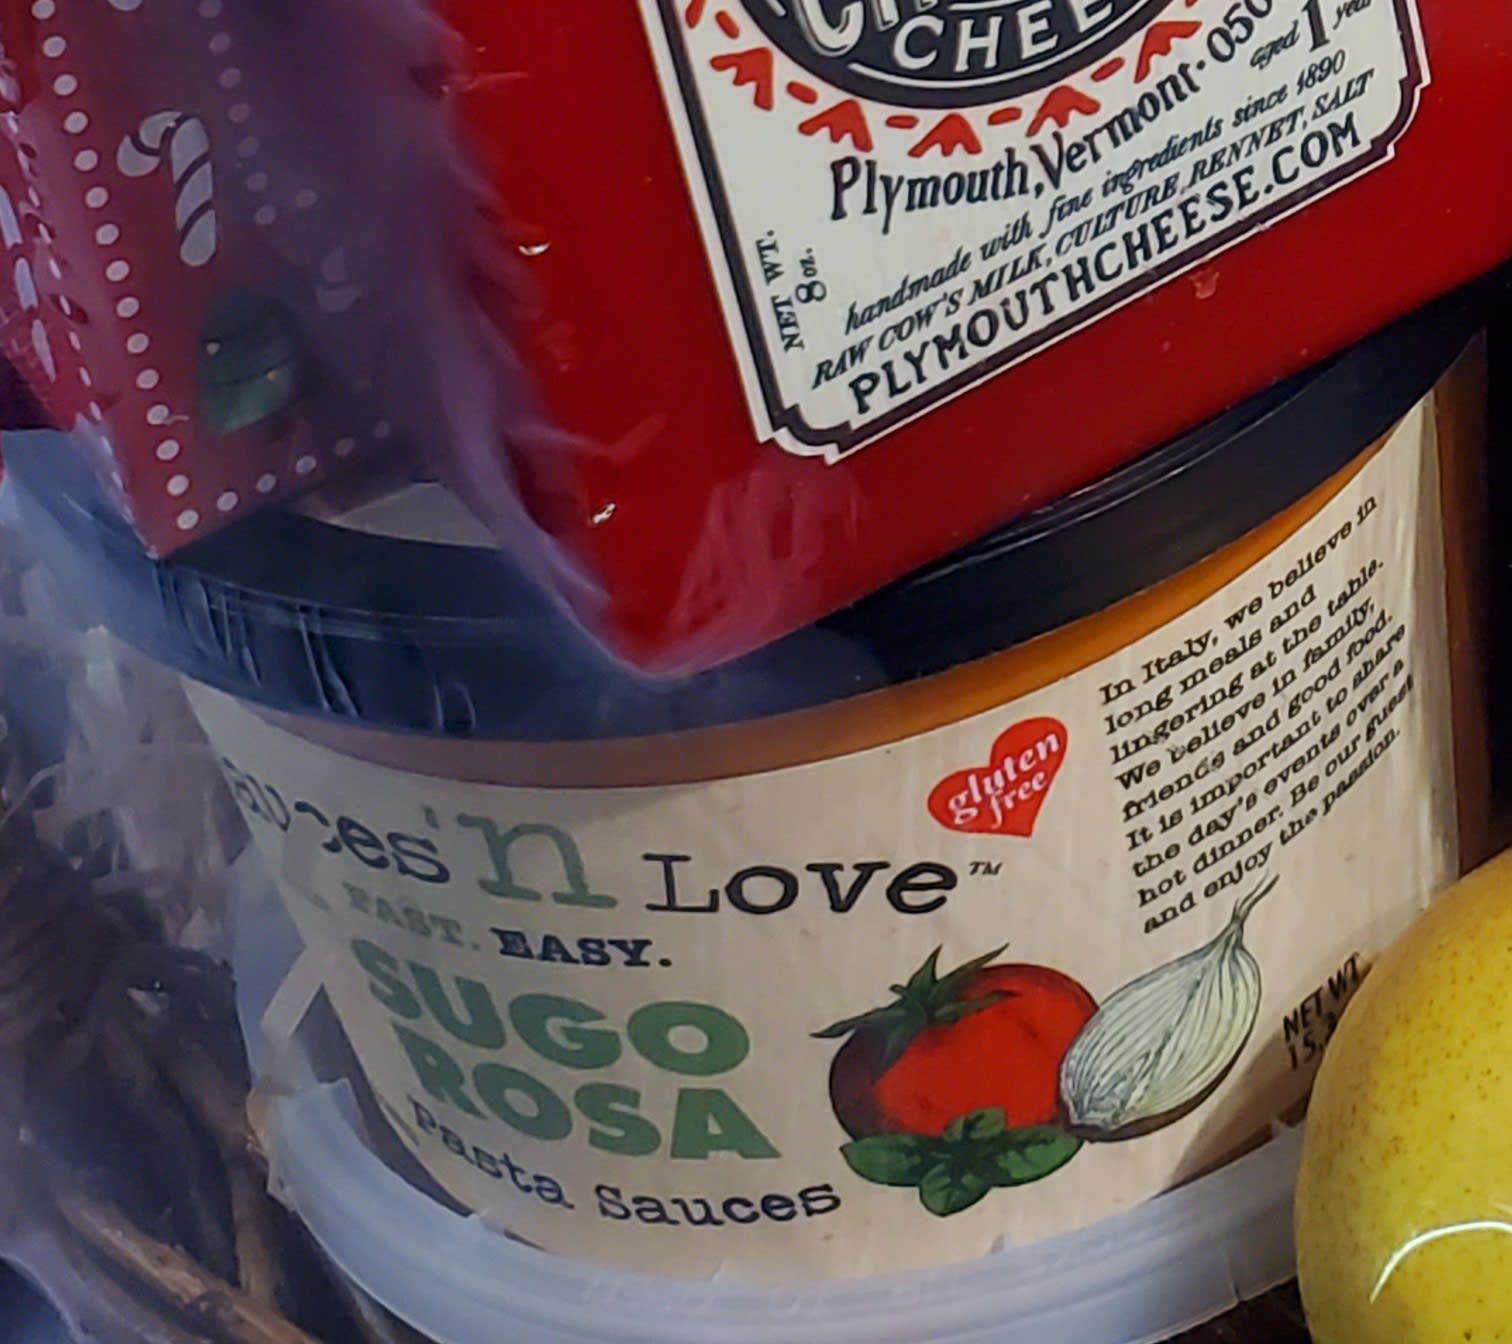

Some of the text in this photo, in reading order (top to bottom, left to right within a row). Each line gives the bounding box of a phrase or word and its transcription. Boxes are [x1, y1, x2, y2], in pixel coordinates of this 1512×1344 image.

[1250, 19, 1301, 71] aged
[755, 229, 806, 353] NET WT.
[811, 342, 872, 390] RAW
[879, 289, 963, 350] COW'S
[966, 252, 1052, 306] MILK,
[1312, 67, 1375, 122] SALT
[843, 48, 1346, 335] handmade with fine ingredients since 1890
[848, 112, 1361, 415] PLYMOUTHCHEESE.COM
[1098, 496, 1378, 706] In Italy, we believe in
[1104, 584, 1318, 736] long meals and
[1109, 558, 1385, 765] lingering at the table.
[1115, 596, 1376, 791] We believe in family,
[948, 733, 1060, 825] gluten
[990, 770, 1046, 830] free
[1122, 608, 1393, 823] friends and good food.
[1125, 623, 1406, 852] It is important to share
[1131, 658, 1405, 878] the day's events over a
[1136, 673, 1415, 908] hot dinner. Be our guest
[1143, 727, 1401, 935] and enjoy the passion.
[349, 938, 751, 1077] SUGO
[490, 926, 673, 968] EASY.
[390, 1020, 783, 1161] ROSA
[406, 1094, 842, 1227] Pasta Sauces
